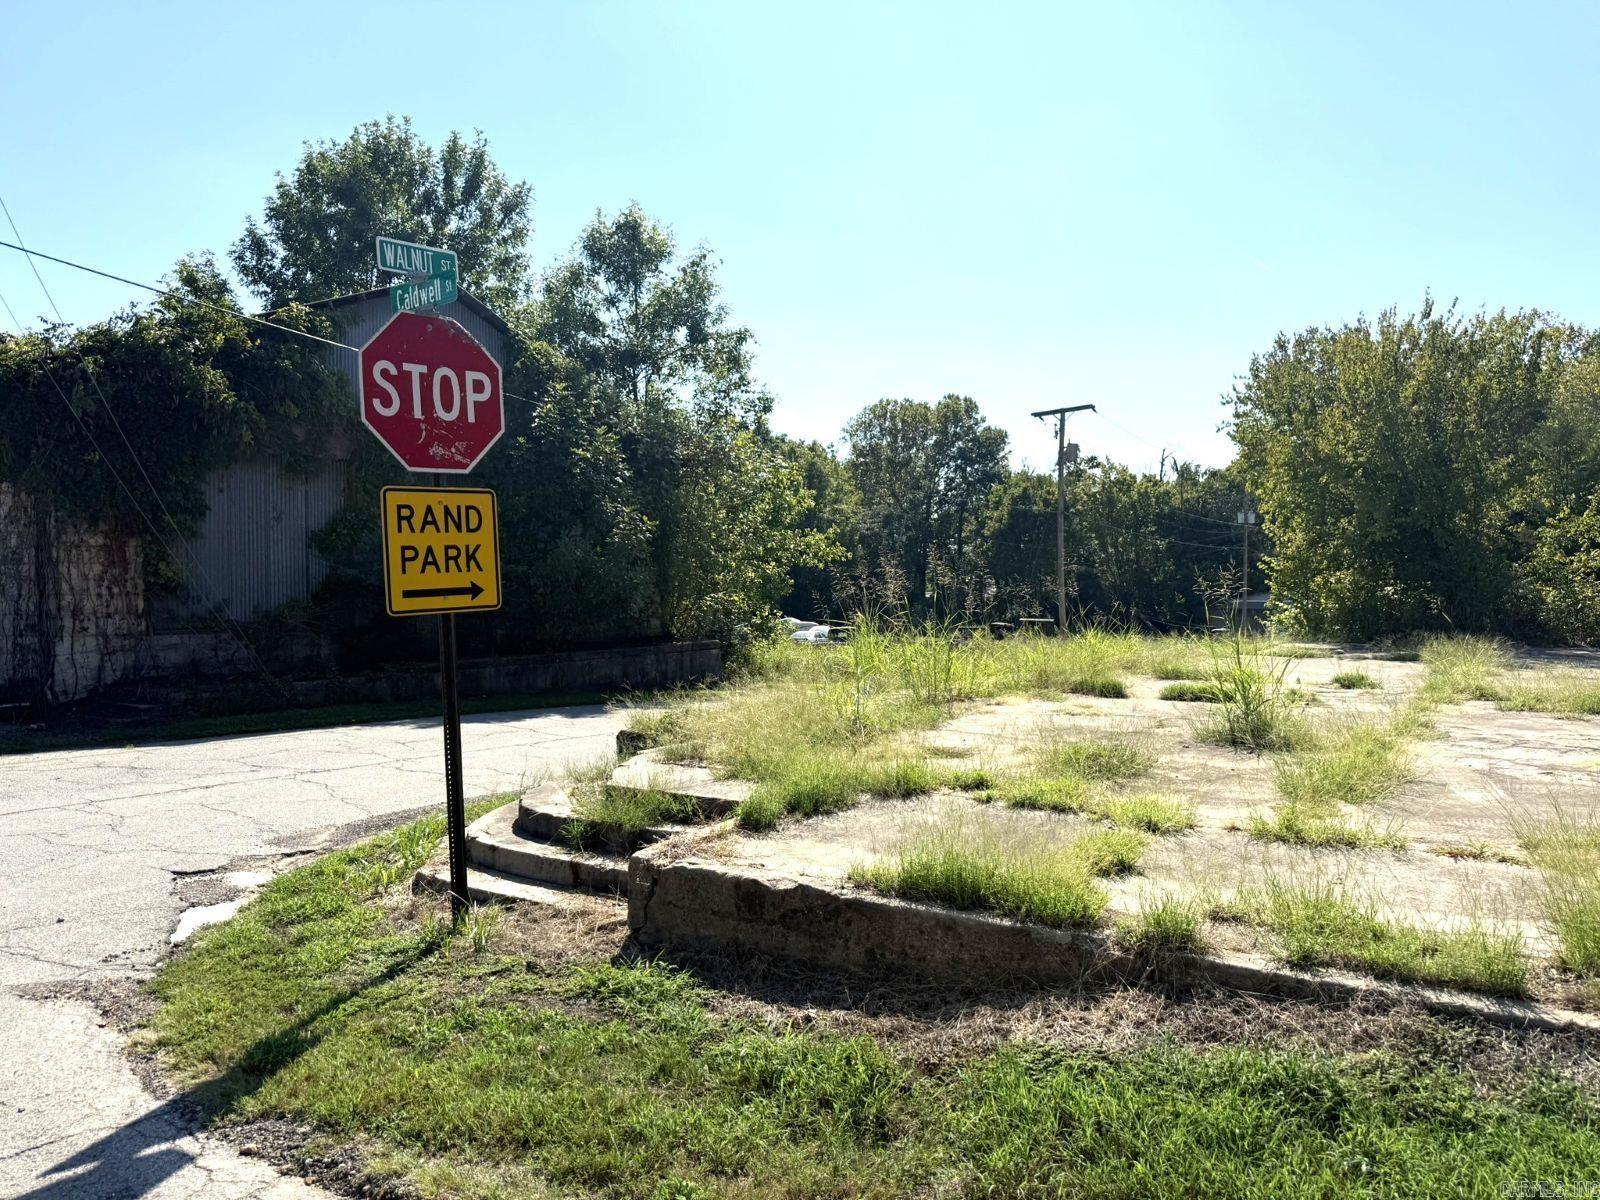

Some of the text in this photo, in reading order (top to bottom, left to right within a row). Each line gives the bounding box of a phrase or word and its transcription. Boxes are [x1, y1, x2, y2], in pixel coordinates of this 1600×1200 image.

[383, 242, 434, 274] WALNUT
[396, 277, 441, 310] Caldwell
[372, 359, 492, 424] STOP
[396, 504, 483, 534] RAND
[400, 544, 484, 574] PARK
